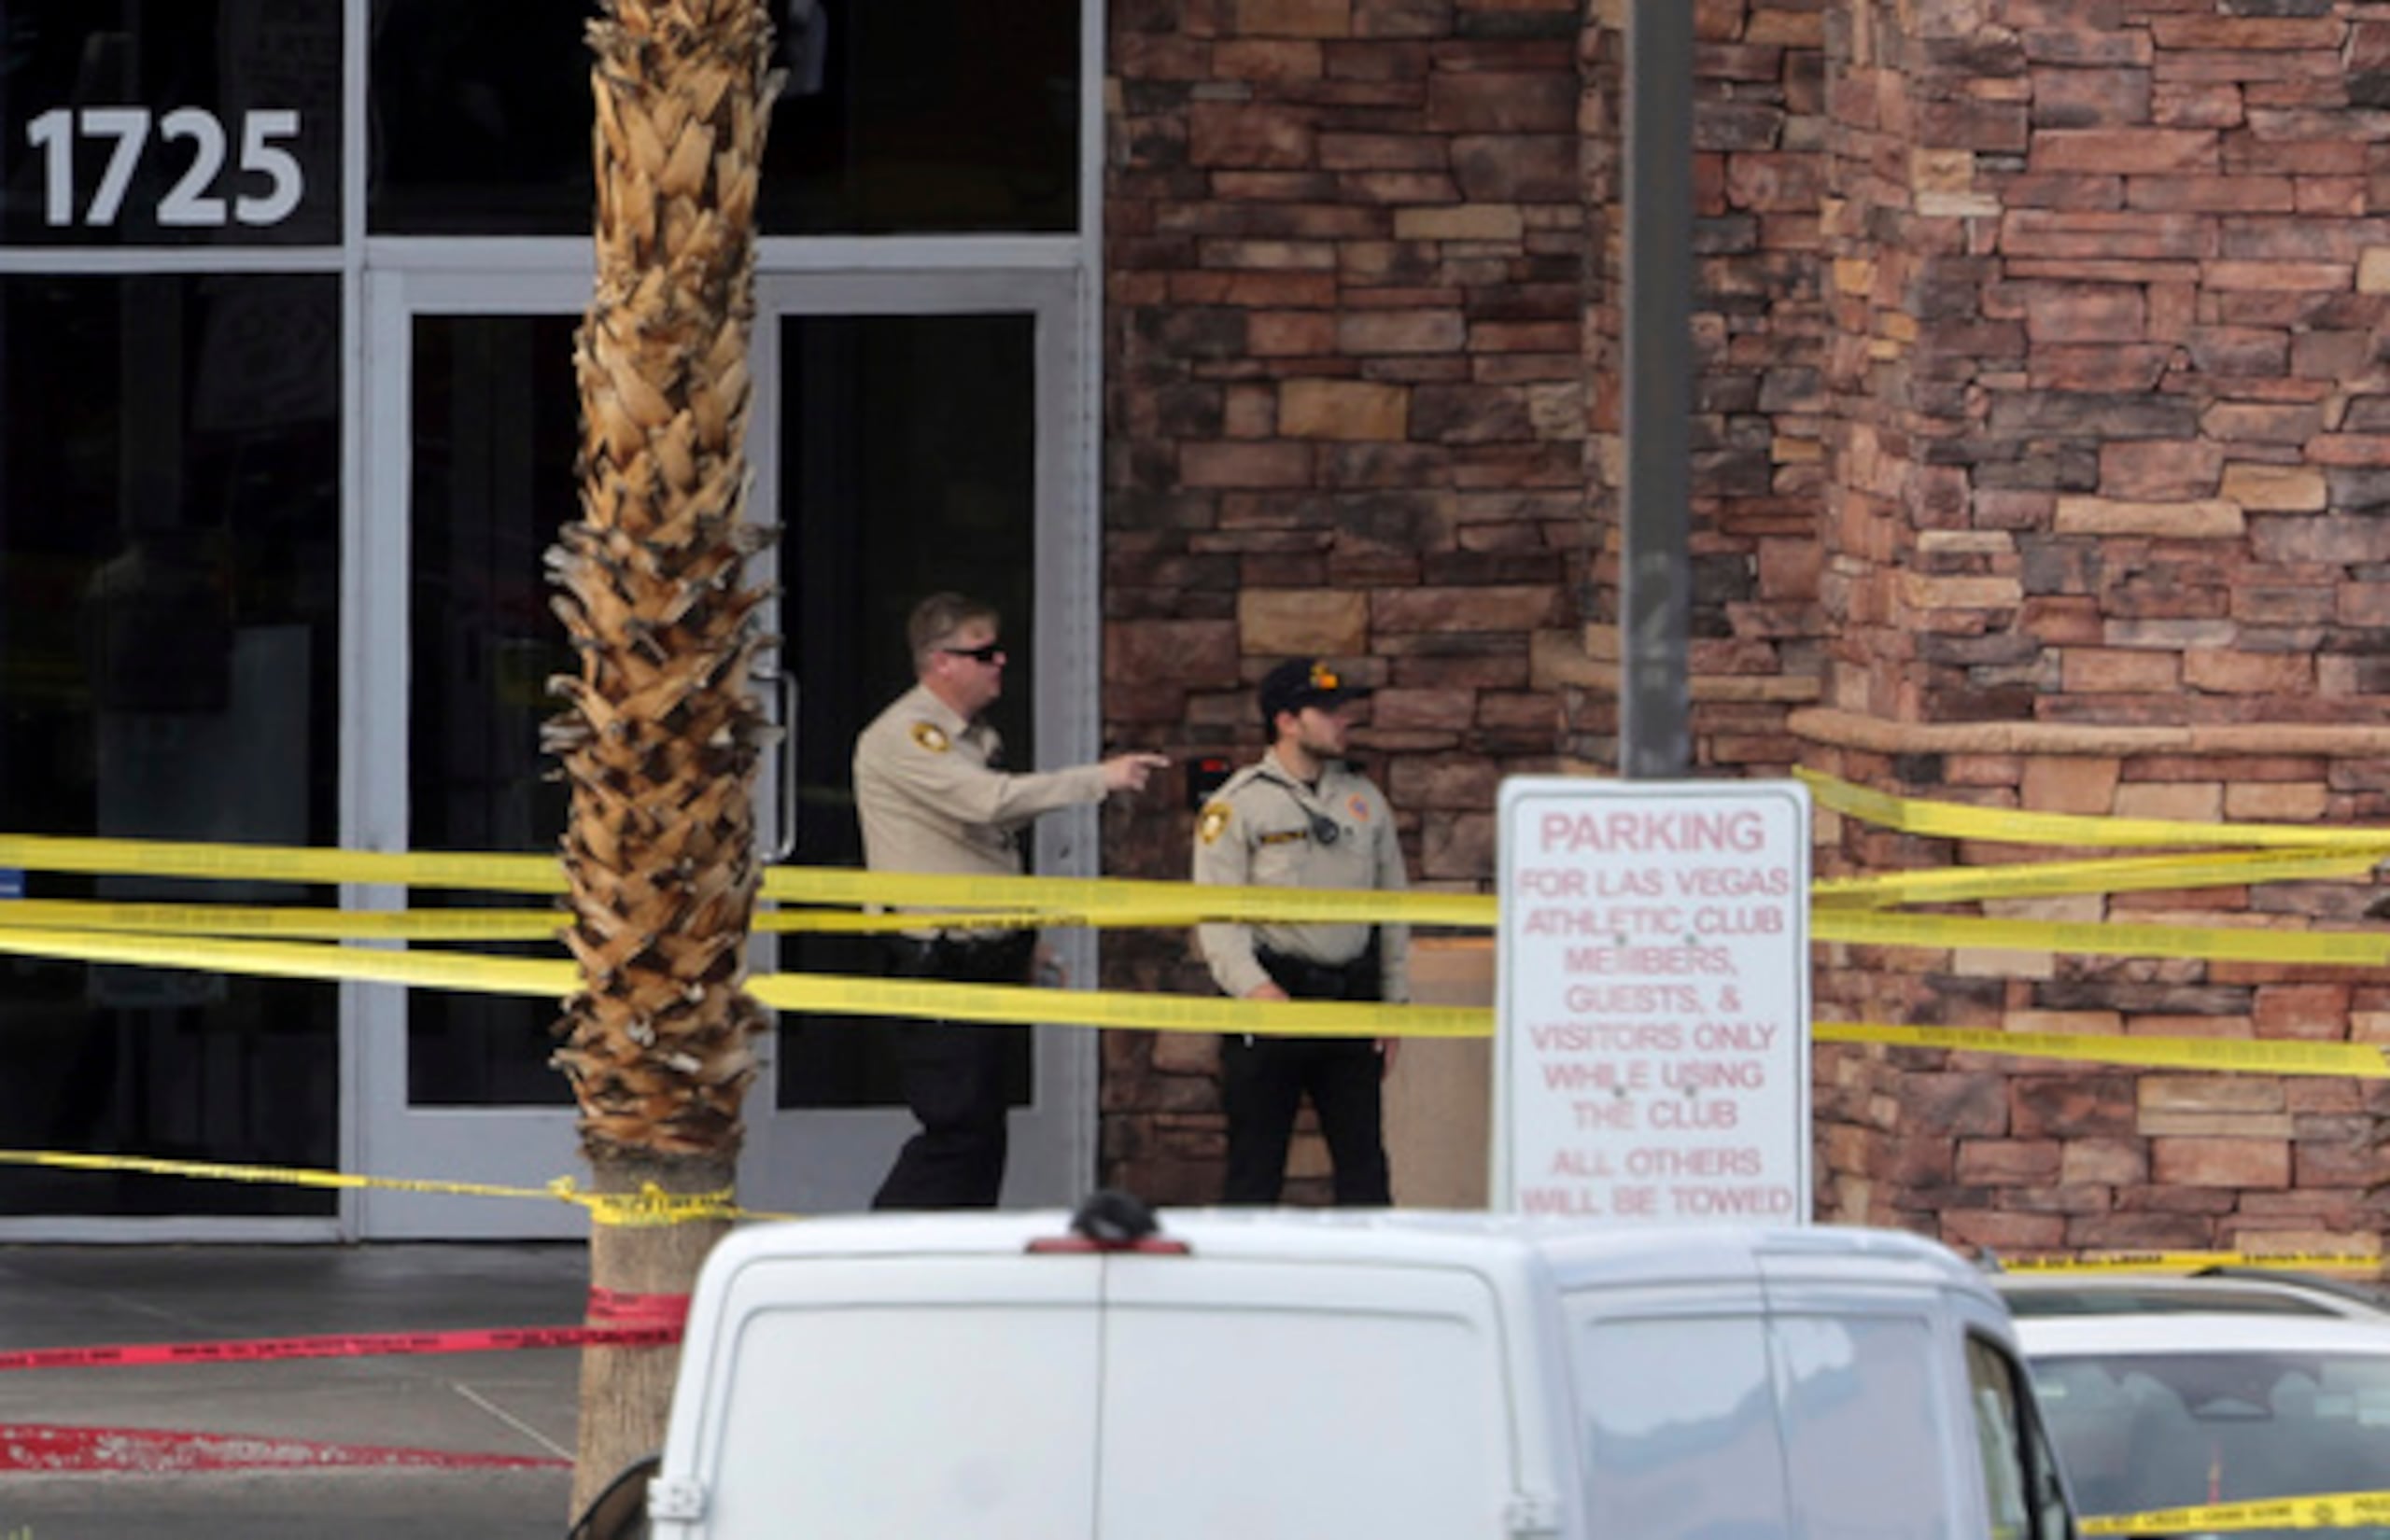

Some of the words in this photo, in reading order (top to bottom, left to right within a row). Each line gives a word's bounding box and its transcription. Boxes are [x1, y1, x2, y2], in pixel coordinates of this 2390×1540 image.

[27, 107, 303, 225] 1725
[1541, 809, 1766, 853] PARKING
[1519, 867, 1589, 898] FOR
[1596, 867, 1665, 898] LAS
[1675, 867, 1791, 898] VEGAS
[1525, 905, 1684, 936] ATHLETIC
[1693, 904, 1785, 936] CLUB
[1717, 984, 1743, 1014] &
[1528, 1023, 1684, 1053] VISITORS
[1691, 1023, 1778, 1053] ONLY
[1543, 1060, 1651, 1090] WHILE
[1659, 1060, 1766, 1091] USING
[1571, 1099, 1636, 1129] THE
[1647, 1099, 1740, 1131] CLUB
[1550, 1148, 1614, 1178] ALL
[1624, 1146, 1764, 1178] OTHERS
[1520, 1186, 1602, 1217] WILL
[1610, 1186, 1660, 1216] BE
[1667, 1185, 1793, 1216] TOWED
